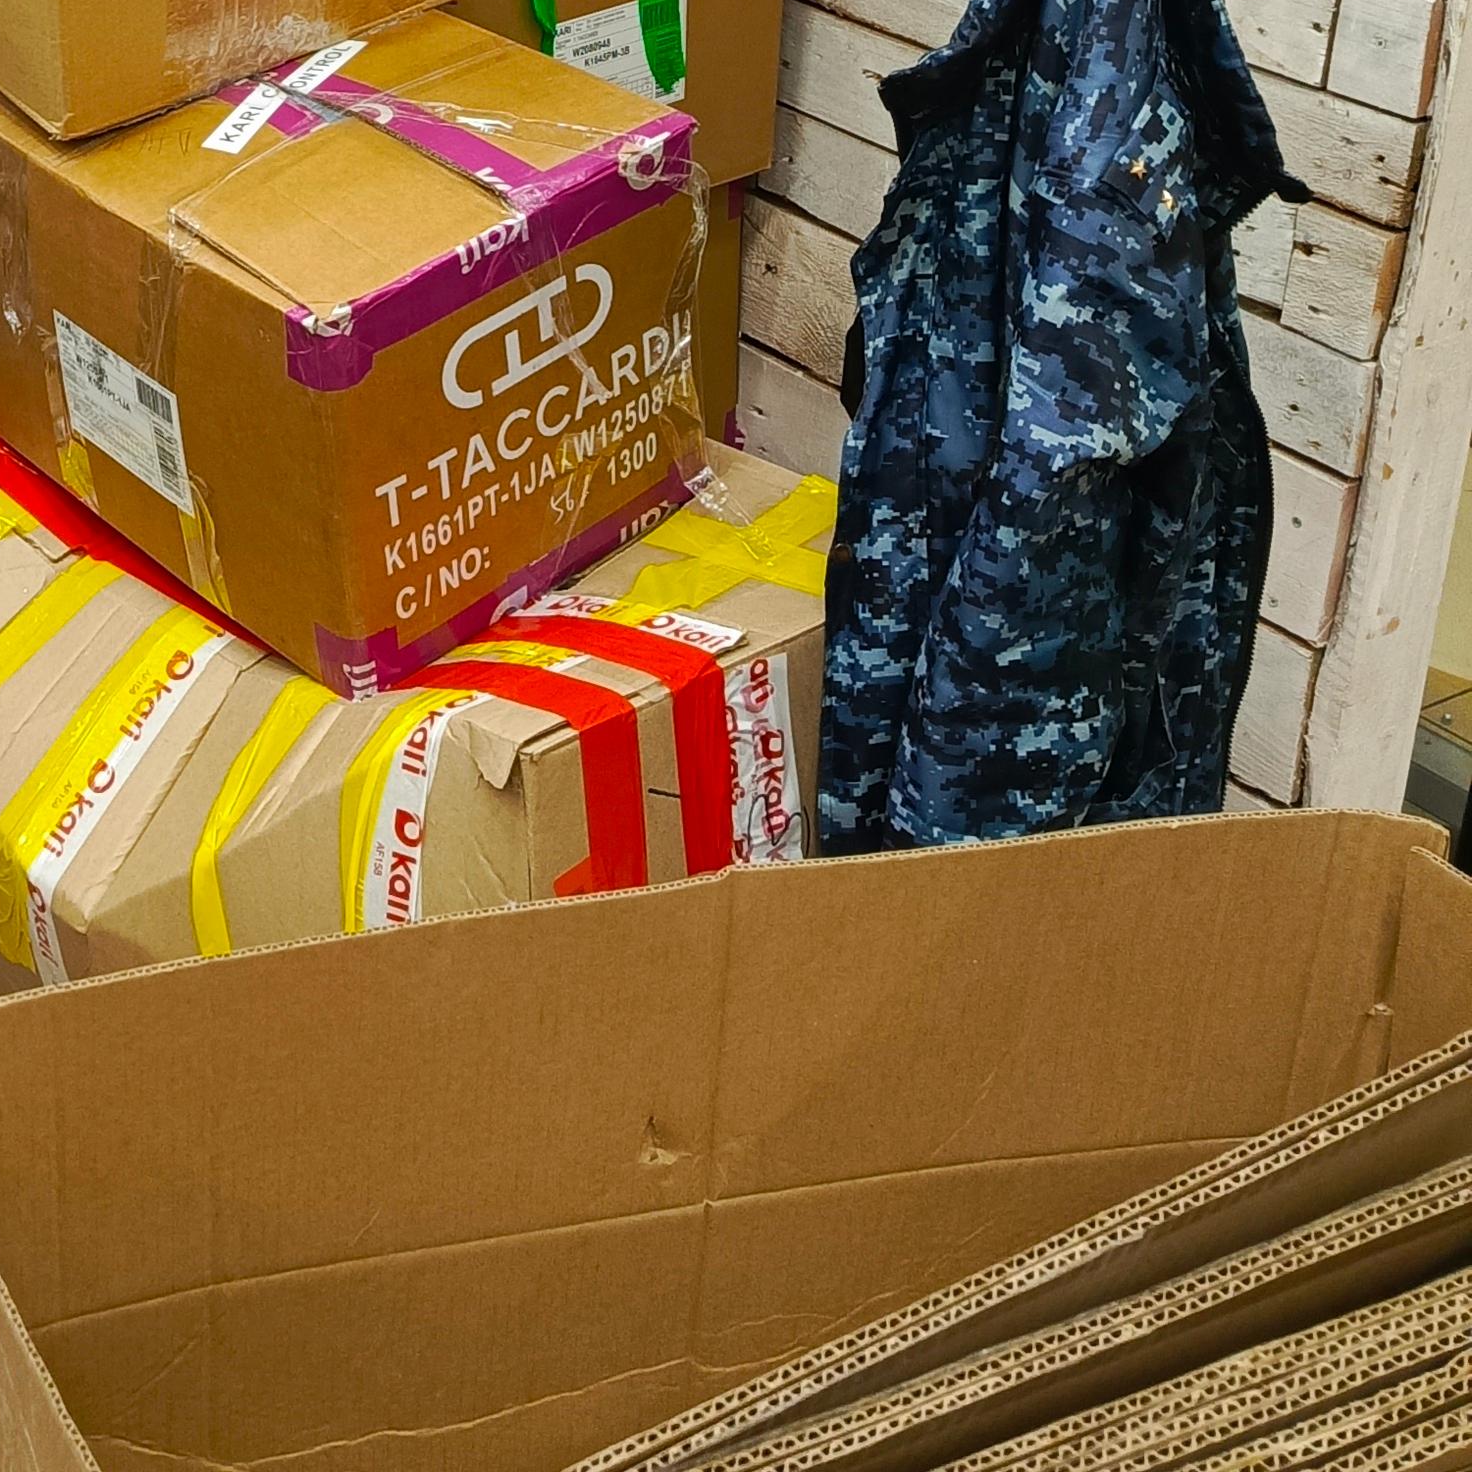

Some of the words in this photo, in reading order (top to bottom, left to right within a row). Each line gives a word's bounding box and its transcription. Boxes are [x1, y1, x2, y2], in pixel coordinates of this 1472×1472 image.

[219, 105, 264, 144] KARI
[606, 432, 658, 486] 1300
[666, 623, 732, 649] kari
[120, 679, 172, 741] kari
[43, 791, 94, 858] kari
